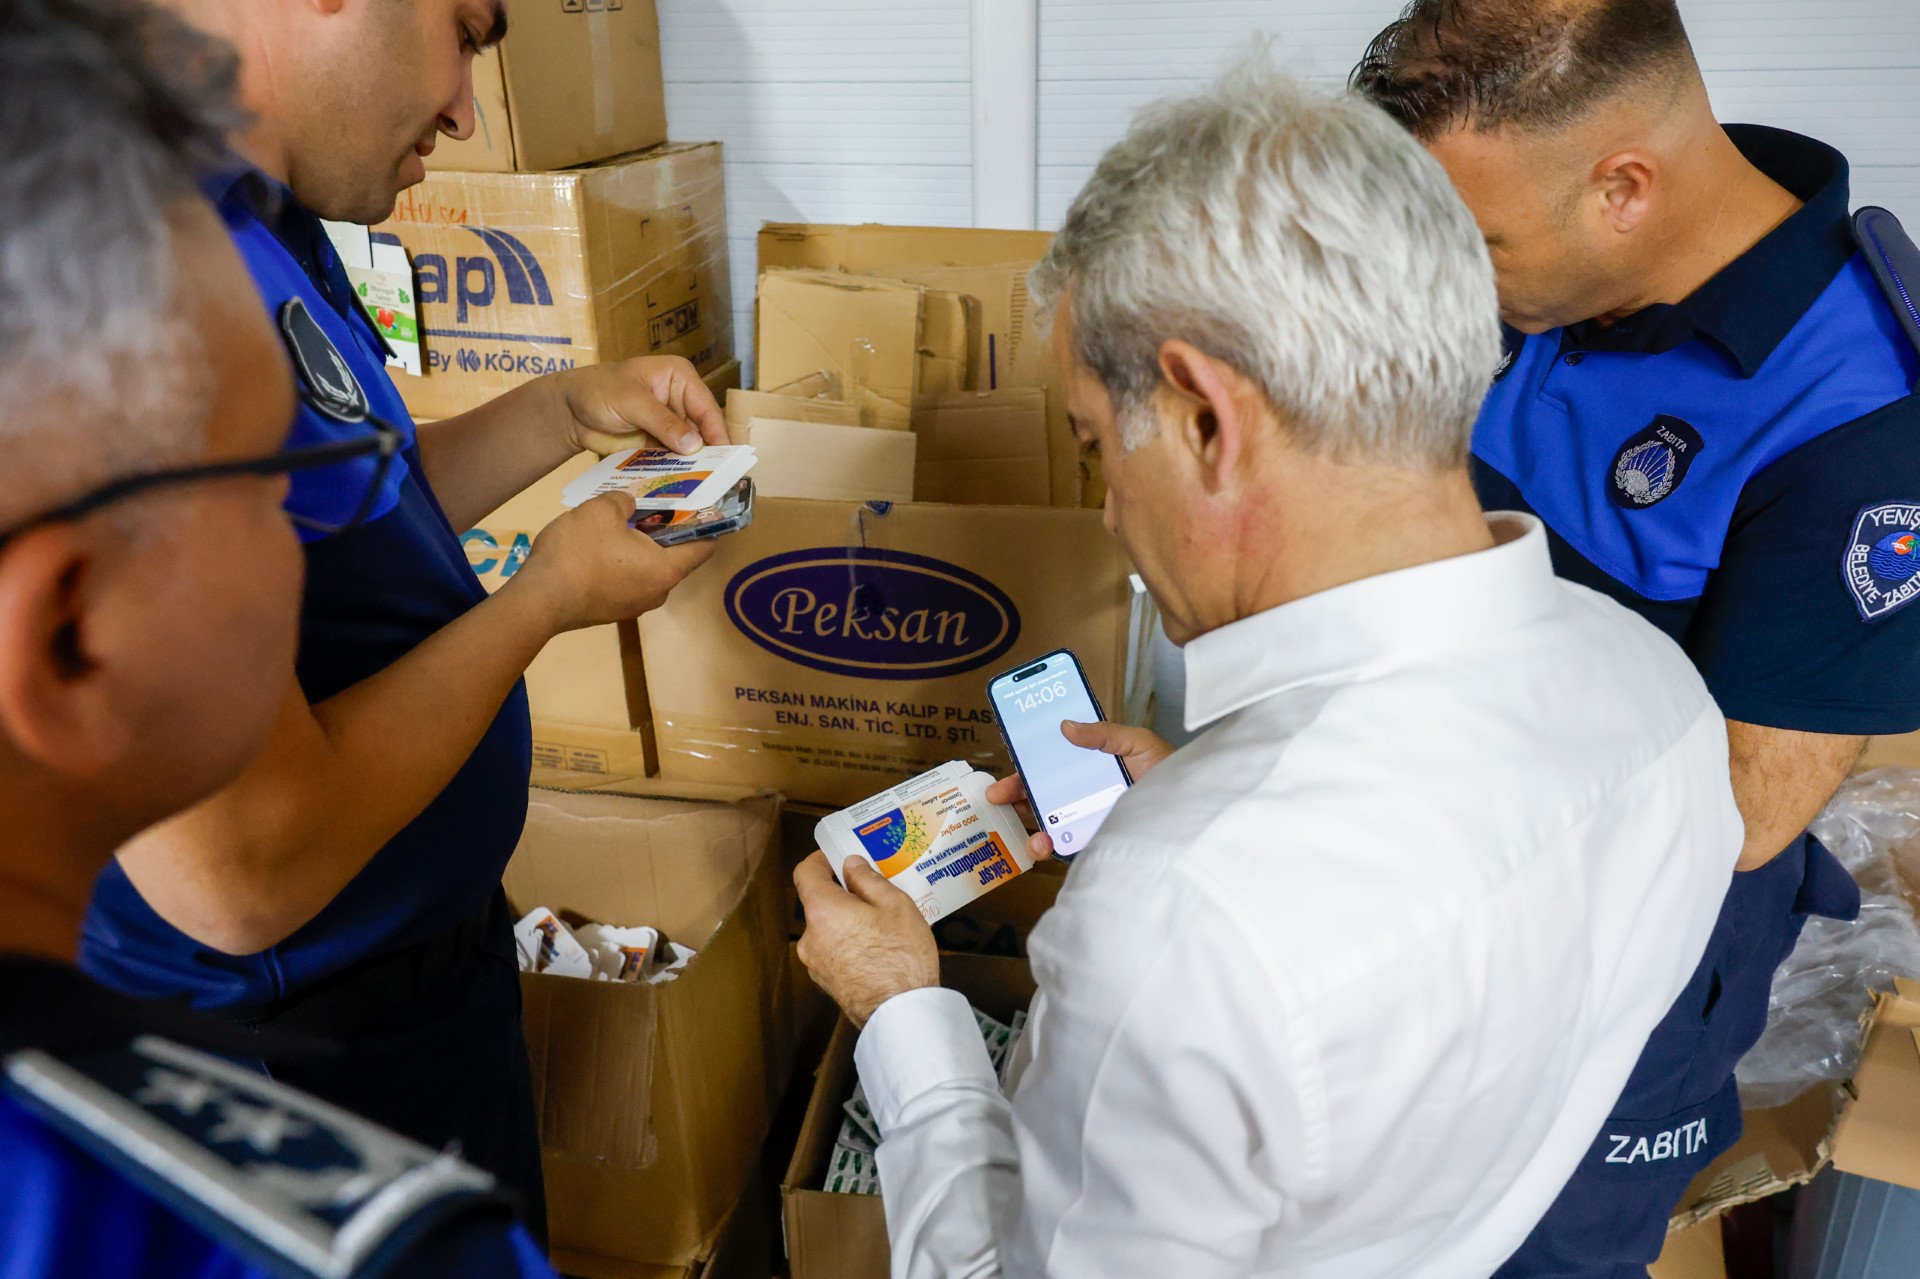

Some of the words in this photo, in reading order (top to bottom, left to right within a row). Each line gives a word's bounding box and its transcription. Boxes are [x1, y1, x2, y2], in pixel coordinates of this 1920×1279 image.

[428, 350, 451, 371] By
[485, 350, 575, 375] KÖKSAN
[1656, 425, 1687, 453] ZABITA
[1869, 507, 1920, 531] YENİŞ
[1852, 544, 1882, 604] BELEDİYE
[771, 584, 969, 647] Peksan
[735, 687, 805, 707] PEKSAN
[810, 694, 880, 714] MAKİNA
[886, 702, 939, 719] KALIP
[944, 706, 993, 724] PLAS
[1014, 680, 1067, 714] 14:06
[776, 710, 814, 727] ENJ.
[818, 714, 860, 731] SAN.
[865, 717, 900, 735] TİC.
[905, 722, 942, 739] LTD.
[947, 725, 981, 744] ŞTİ.
[961, 813, 979, 826] 1000
[925, 866, 950, 885] Kapsül
[945, 840, 1002, 878] Epimedium
[978, 857, 1013, 886] Çakşır
[1605, 1117, 1708, 1164] ZABITA
